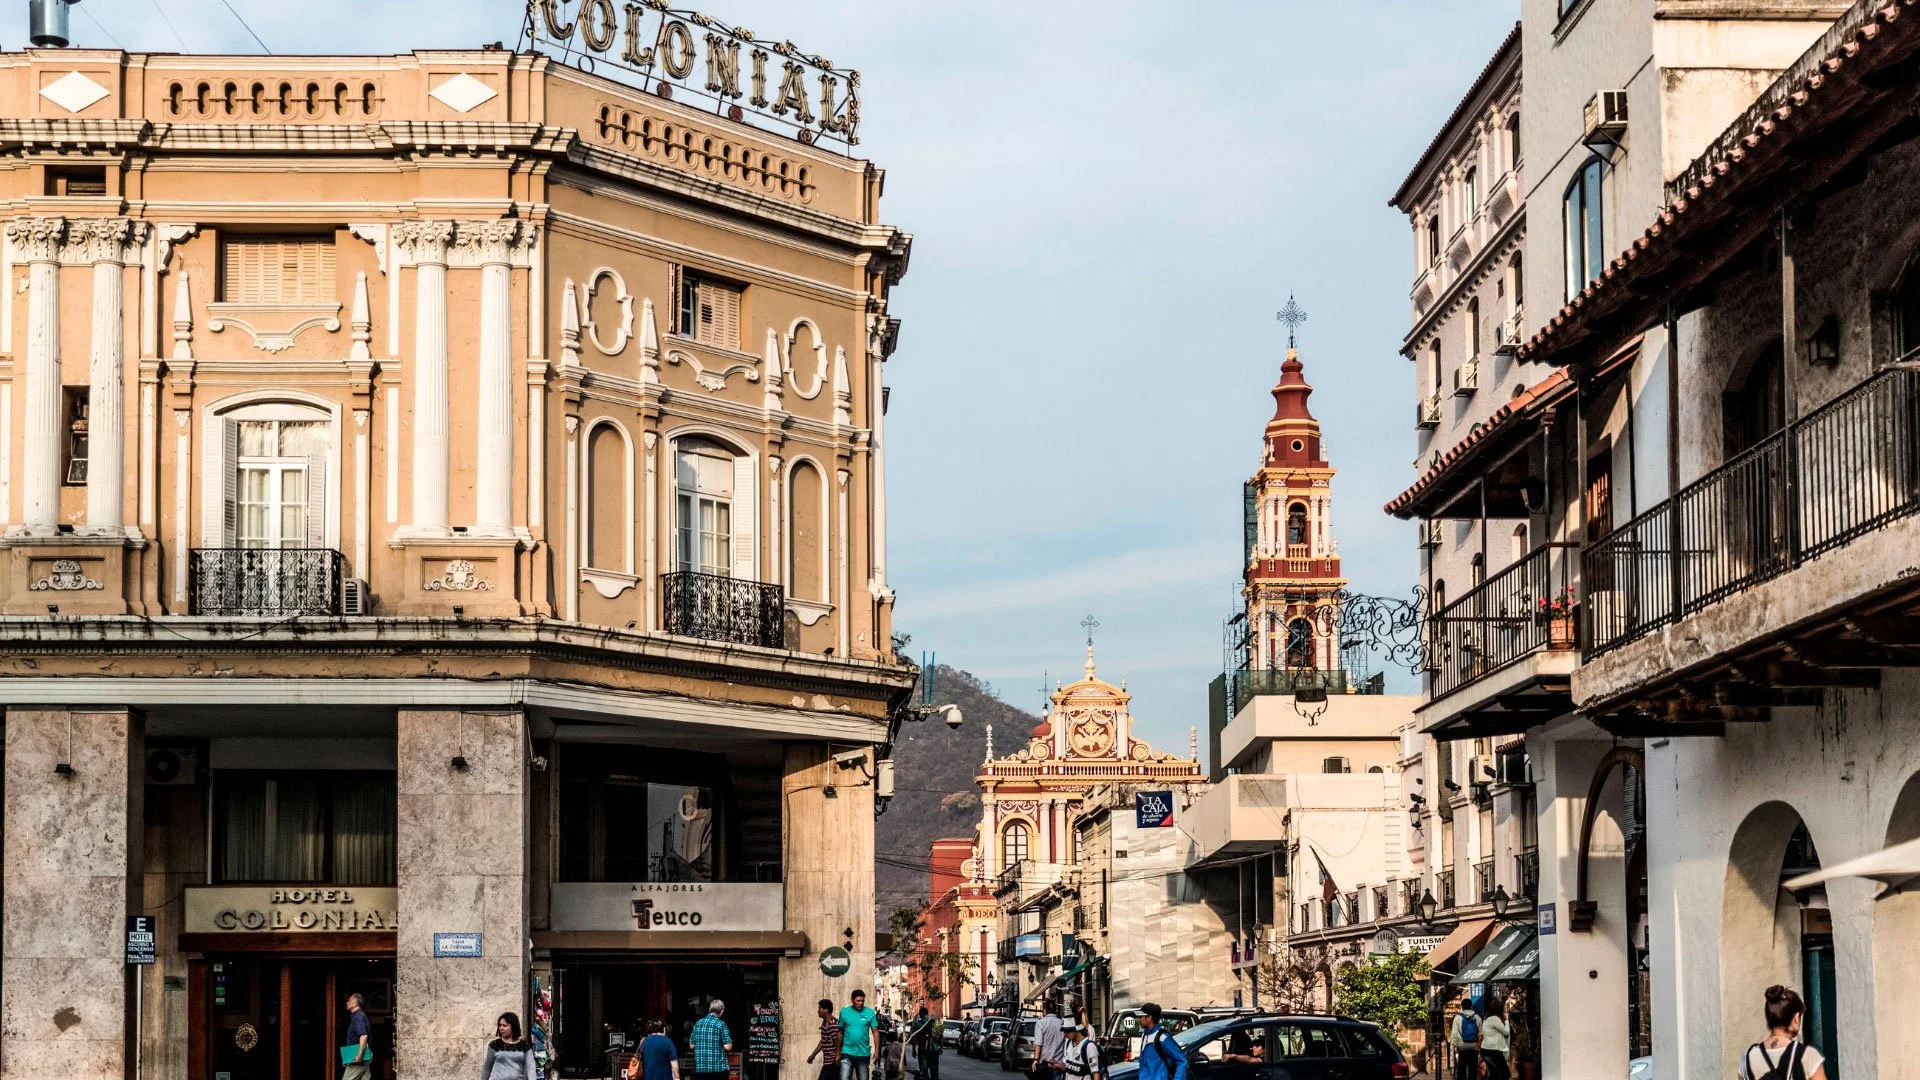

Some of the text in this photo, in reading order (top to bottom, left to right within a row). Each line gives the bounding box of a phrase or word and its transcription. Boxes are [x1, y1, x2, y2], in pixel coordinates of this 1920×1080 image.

[1142, 804, 1168, 814] CAJA
[632, 884, 703, 892] ALFAJORES
[272, 889, 352, 903] HOTEL
[631, 899, 702, 929] Teuco
[973, 910, 996, 918] DEO
[136, 918, 146, 932] E
